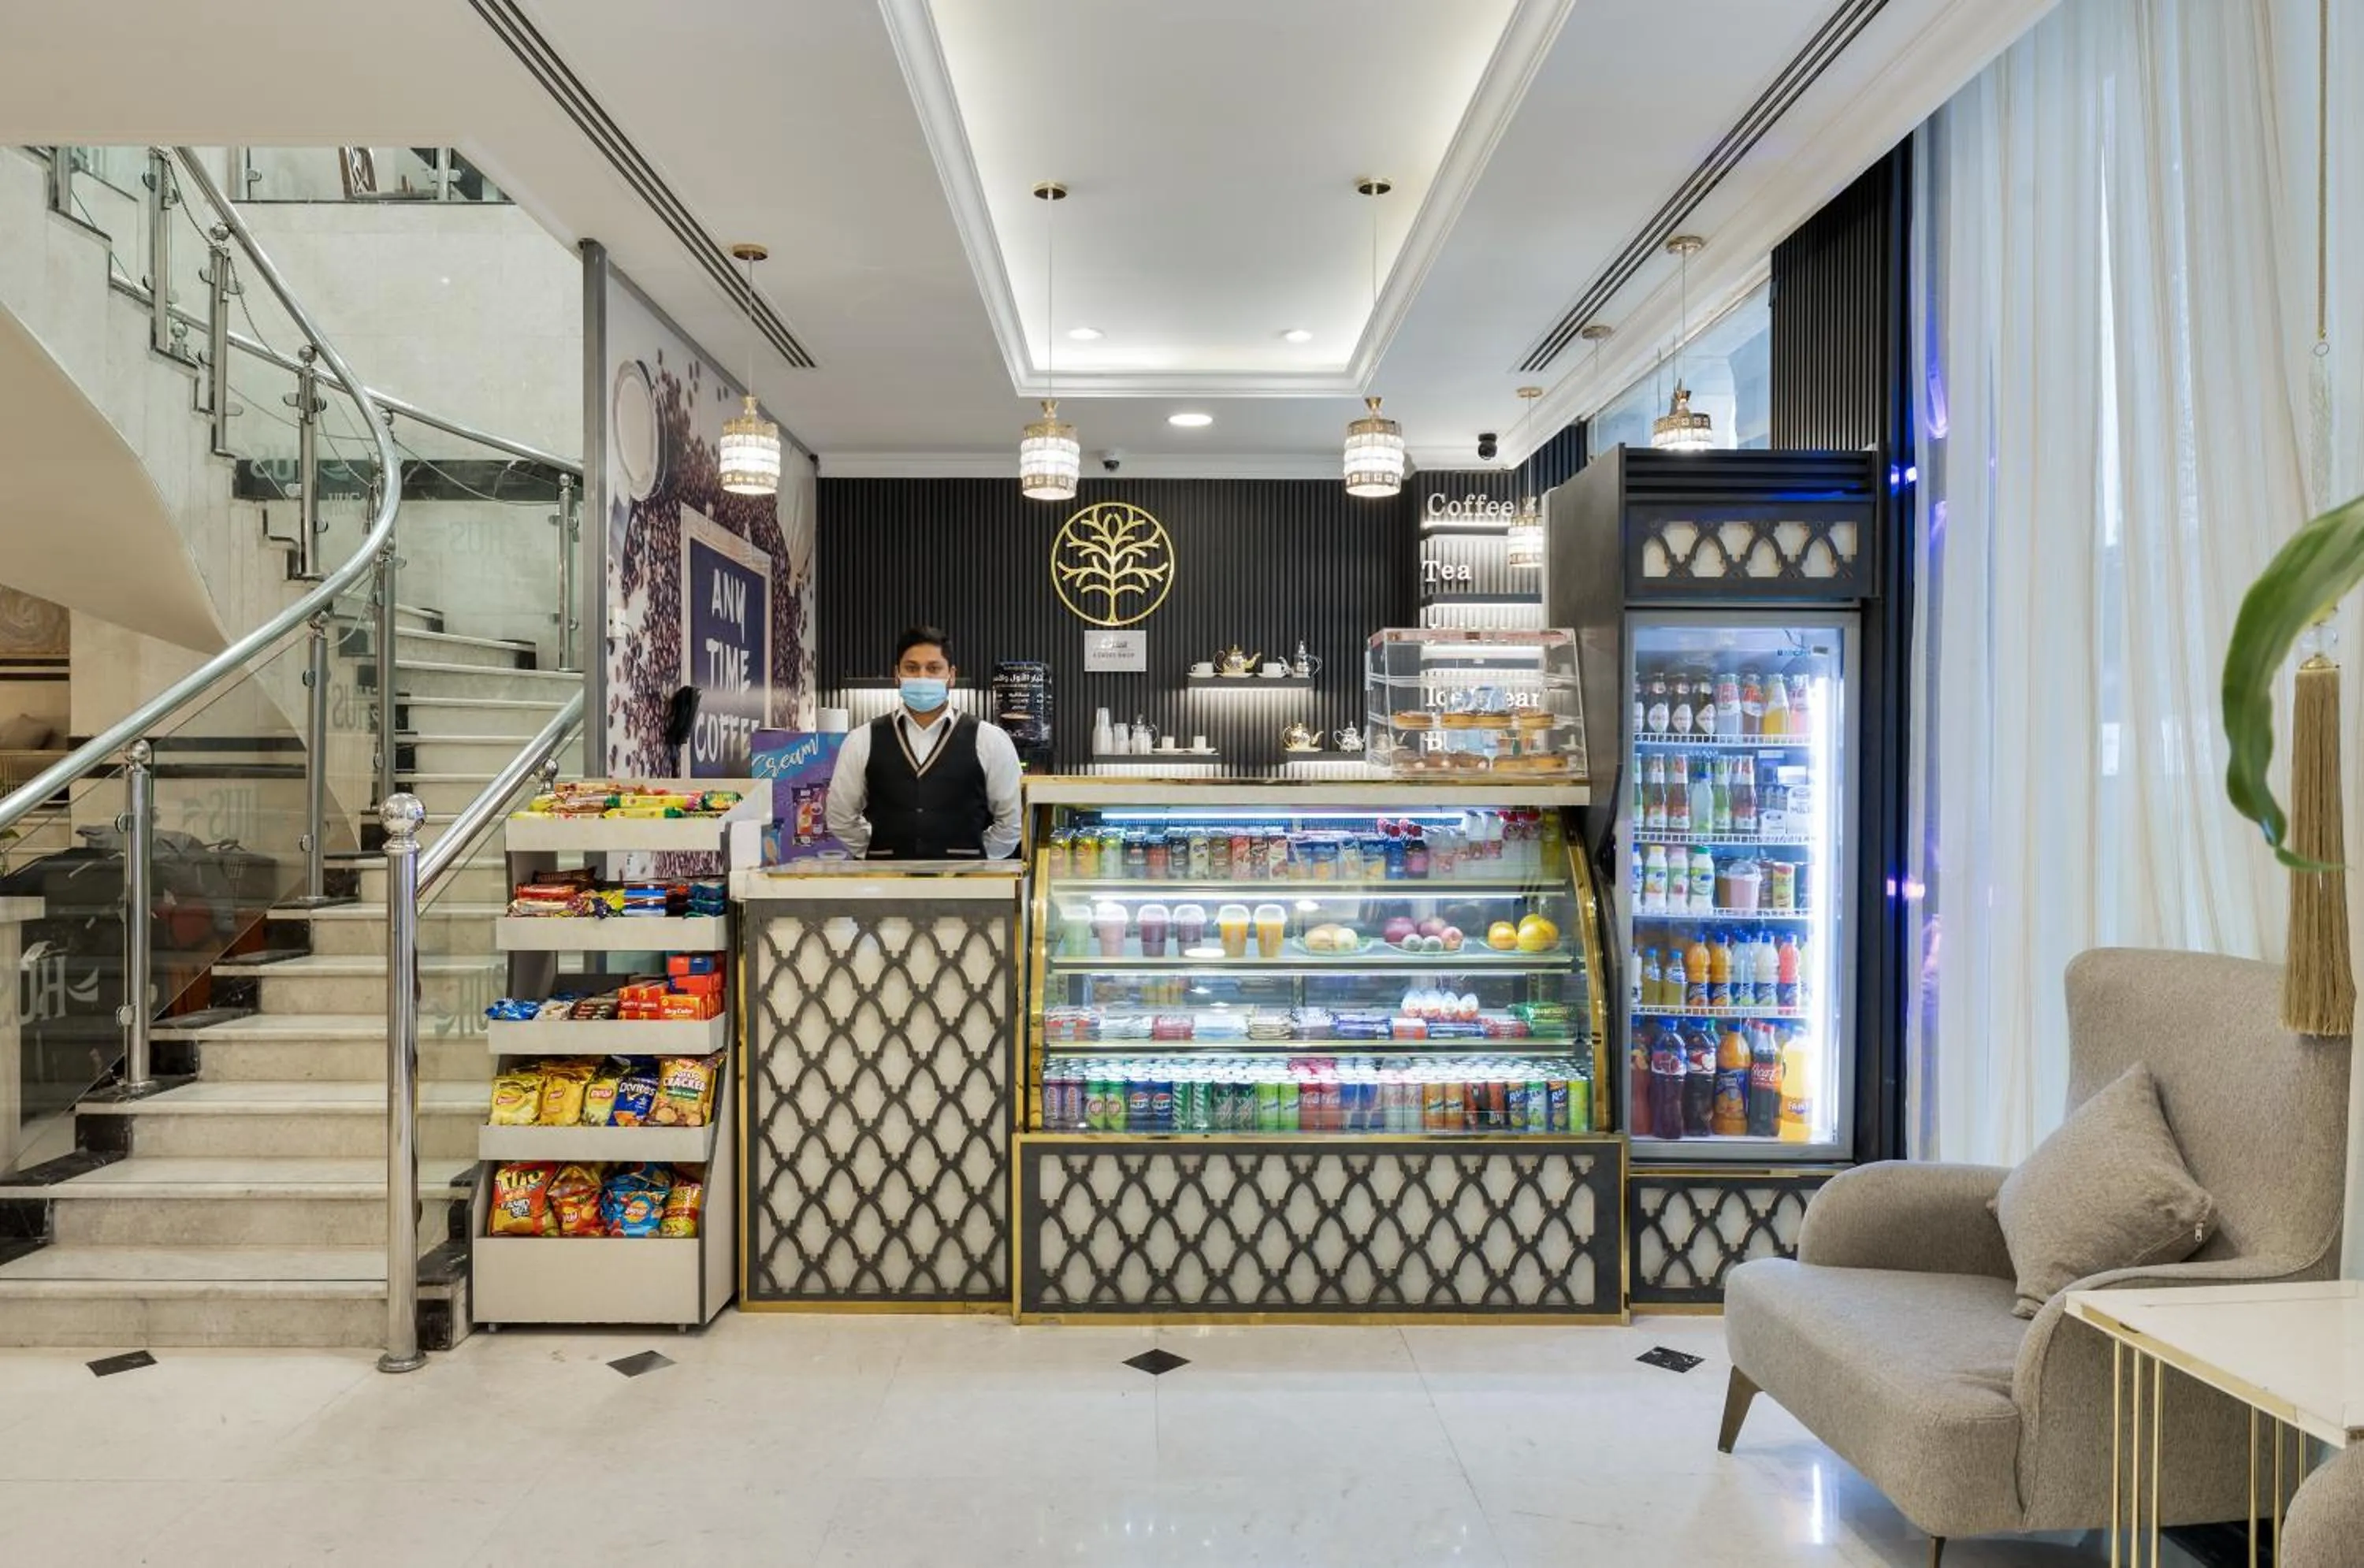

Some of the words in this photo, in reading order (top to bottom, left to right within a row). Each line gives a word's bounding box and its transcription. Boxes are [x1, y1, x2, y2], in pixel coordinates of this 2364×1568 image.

[1427, 493, 1515, 517] Coffee
[1422, 560, 1471, 582] Tea
[706, 638, 751, 696] TIME
[695, 712, 760, 764] COFFE
[619, 1082, 656, 1096] Doritos
